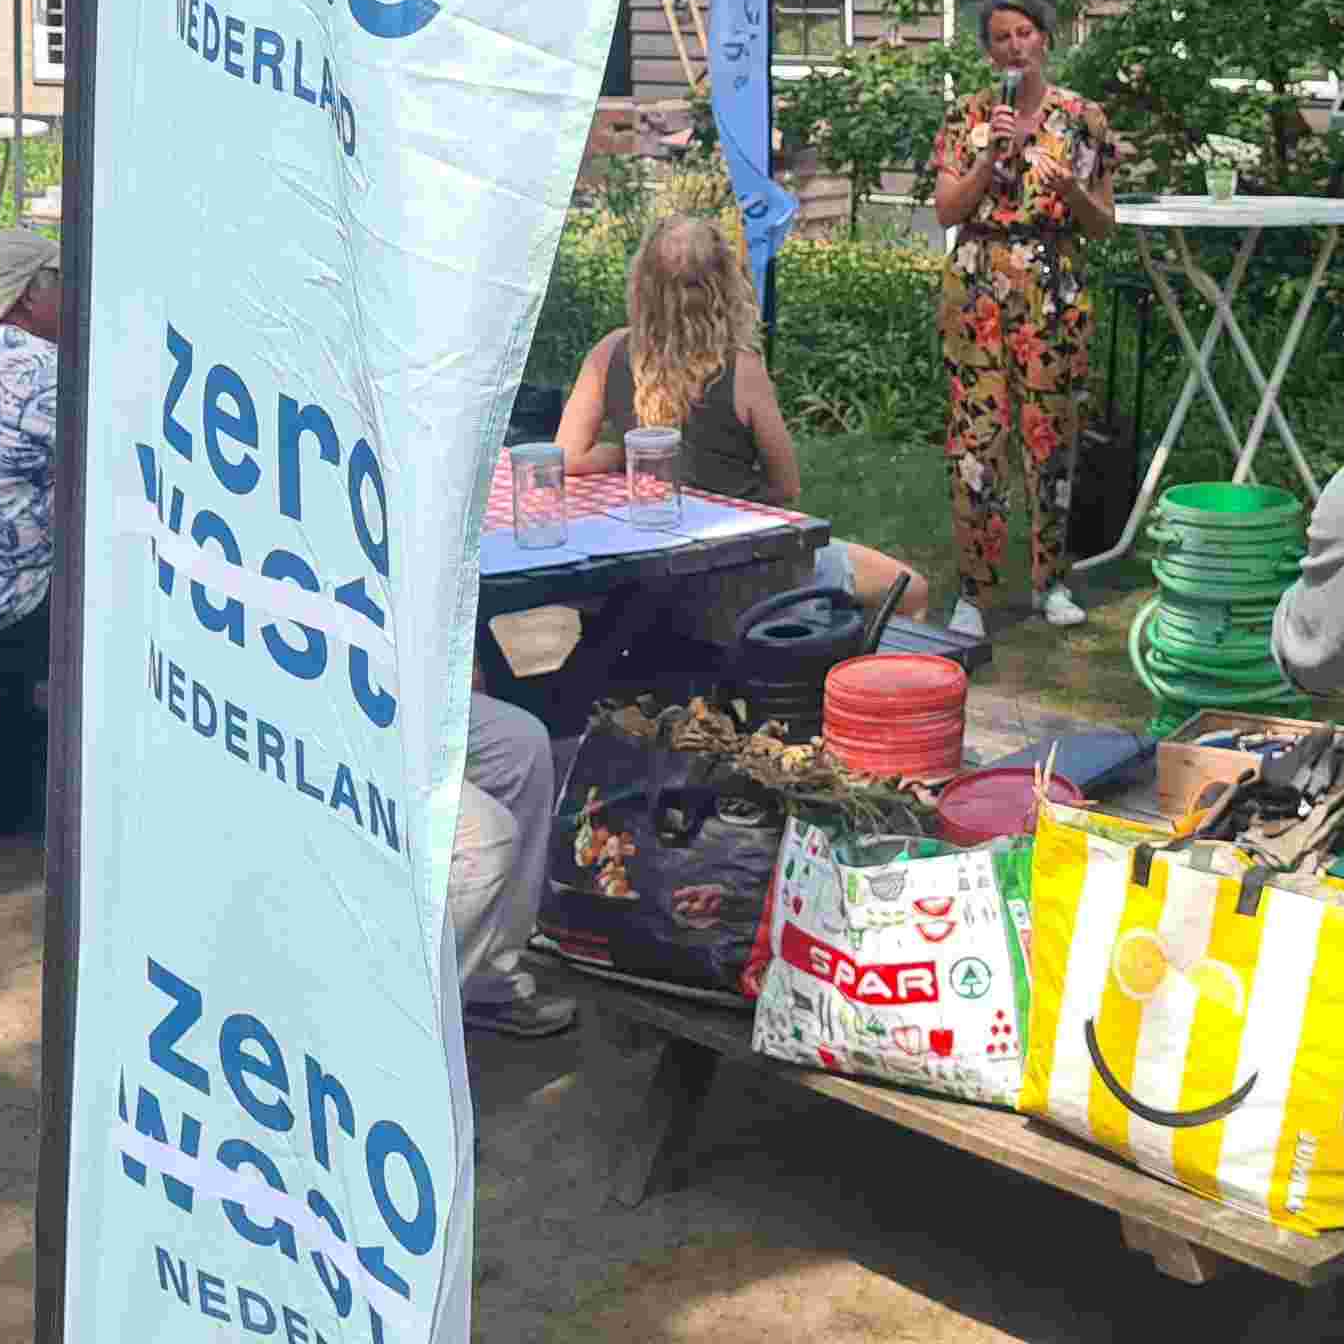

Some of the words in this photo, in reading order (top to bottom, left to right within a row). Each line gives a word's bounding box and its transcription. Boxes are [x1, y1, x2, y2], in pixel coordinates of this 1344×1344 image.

[163, 320, 389, 577] zero
[136, 443, 396, 728] wast
[146, 633, 401, 854] NEDERLAN
[809, 946, 935, 999] SPAR
[147, 955, 437, 1256] zero
